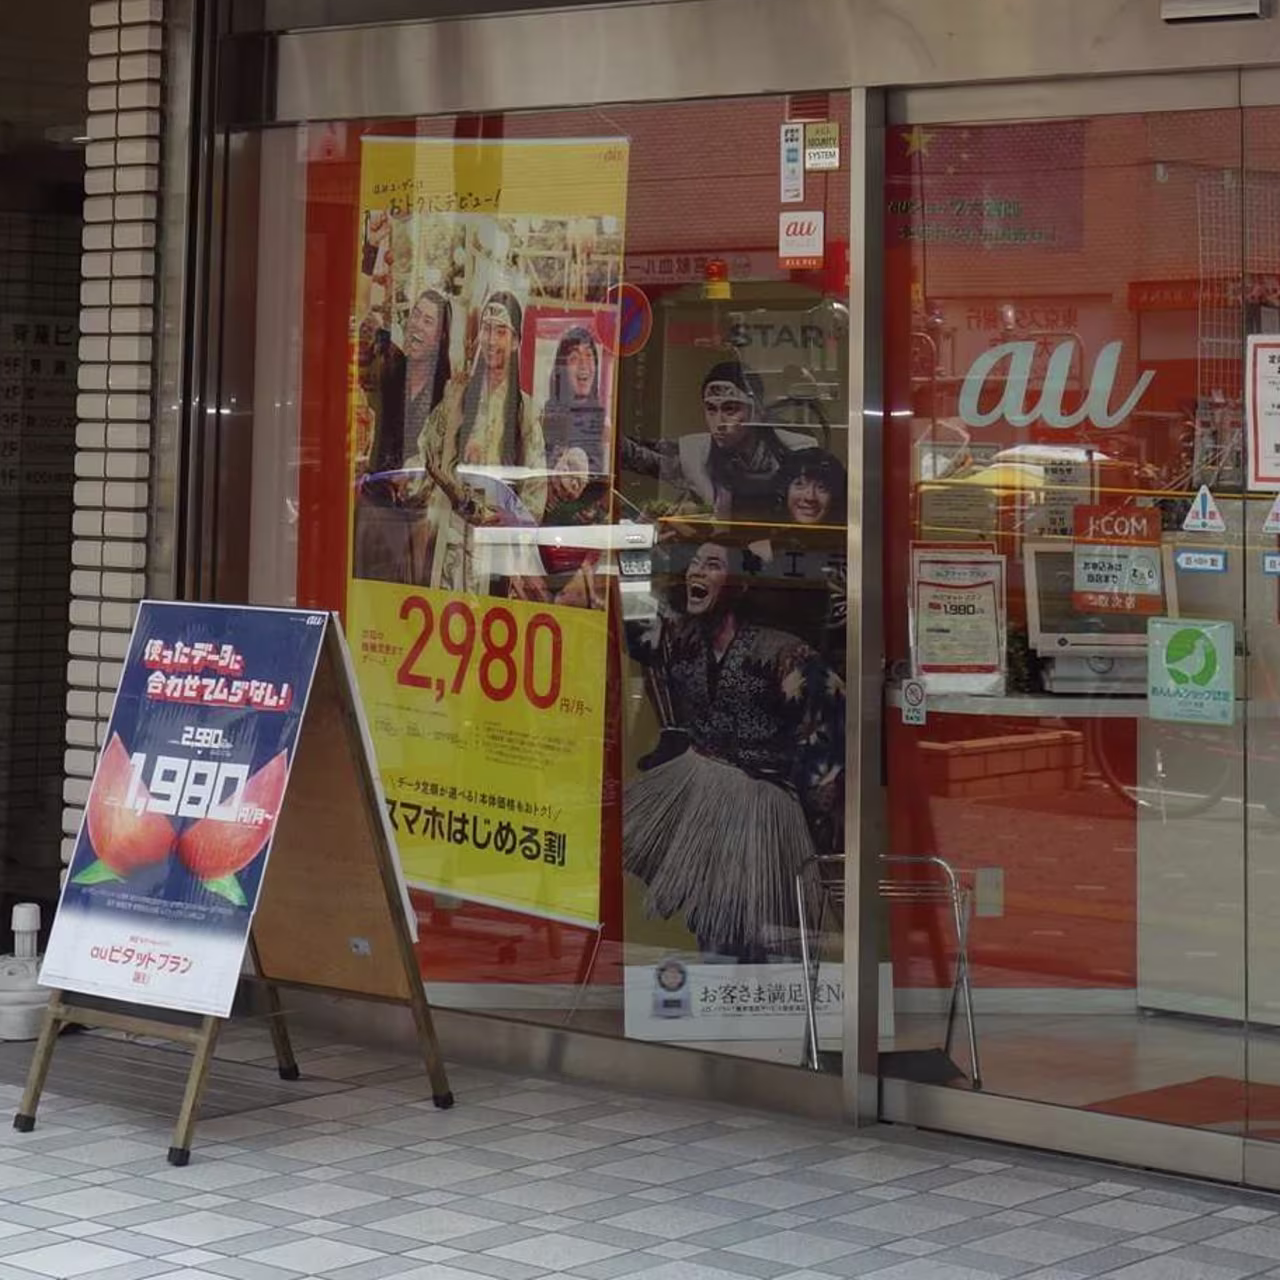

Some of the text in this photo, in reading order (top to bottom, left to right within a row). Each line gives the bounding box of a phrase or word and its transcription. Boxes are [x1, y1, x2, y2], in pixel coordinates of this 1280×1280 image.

[807, 149, 837, 161] SYSTEM
[786, 220, 818, 237] au
[958, 340, 1155, 427] au
[397, 595, 563, 710] 2,980
[700, 982, 844, 1005] お客さま満足度N
